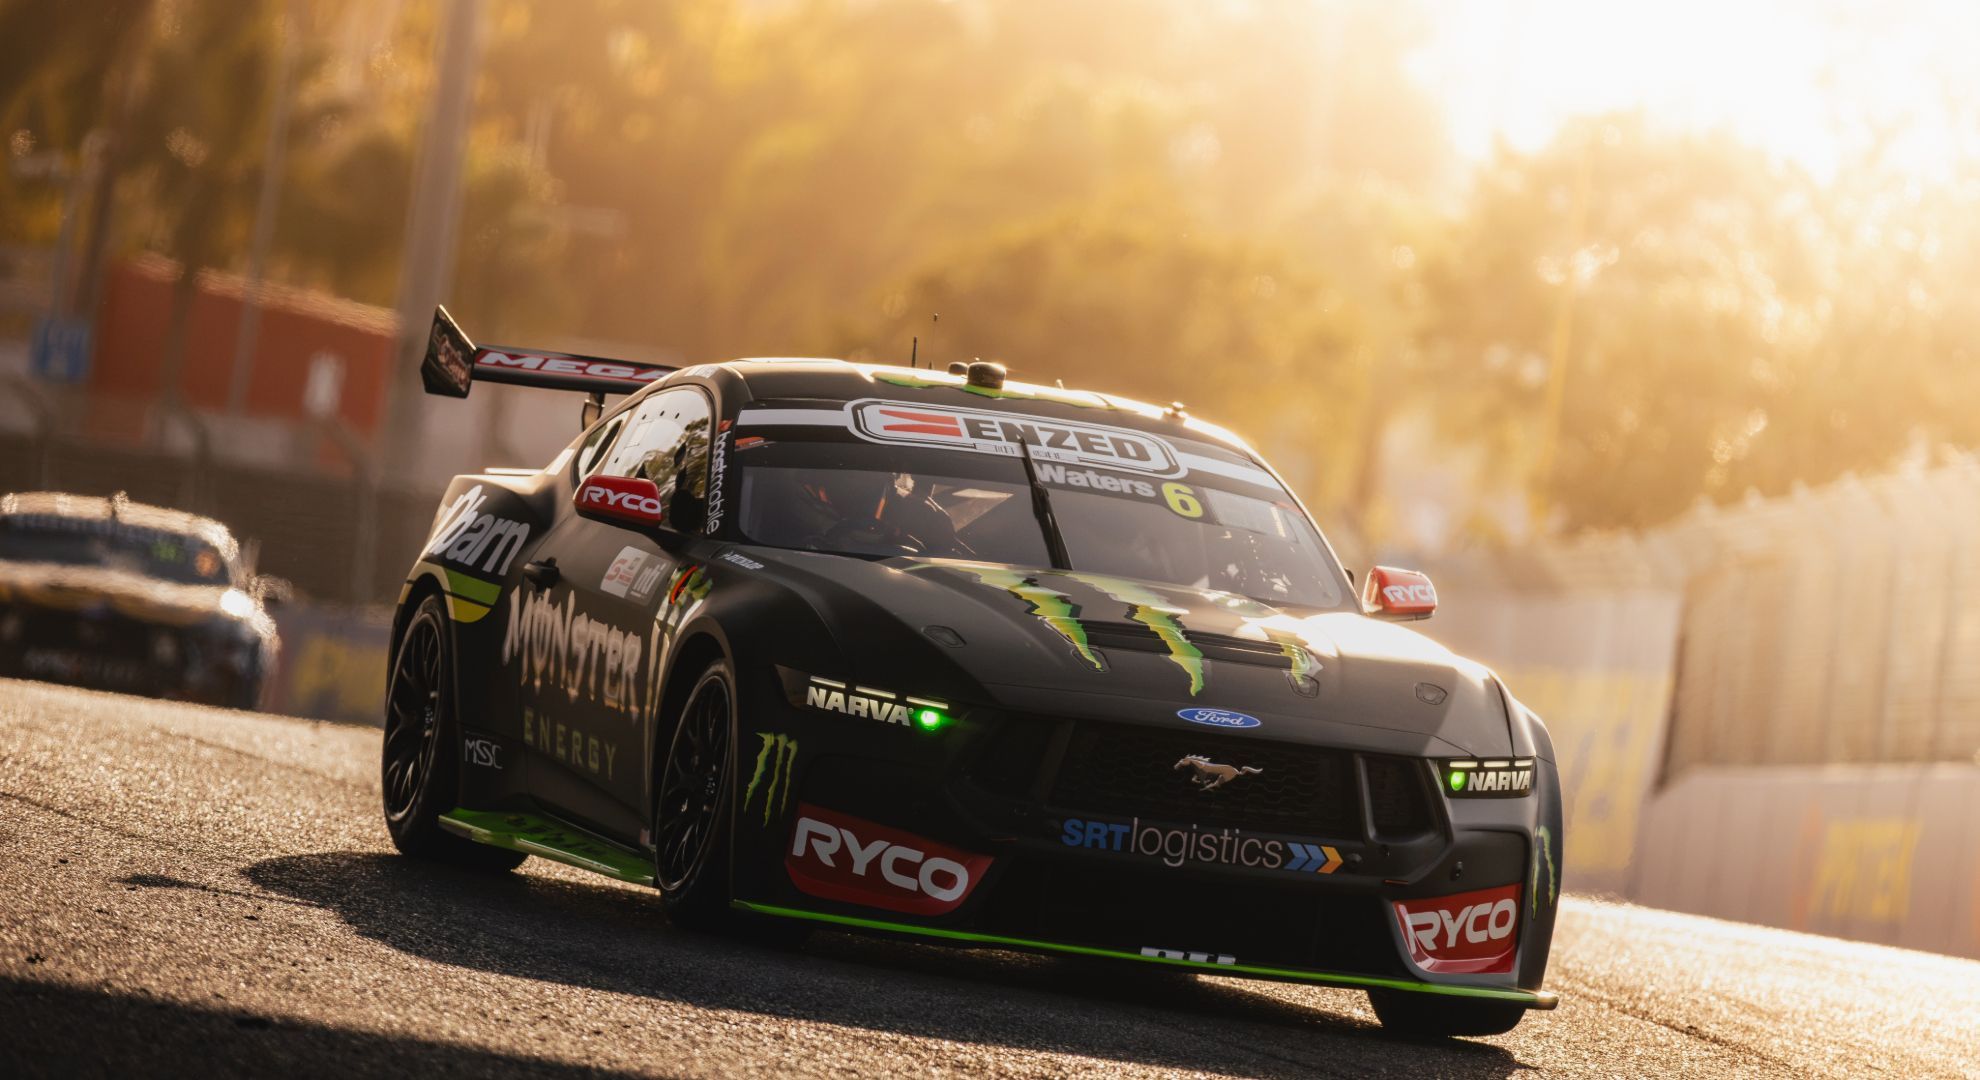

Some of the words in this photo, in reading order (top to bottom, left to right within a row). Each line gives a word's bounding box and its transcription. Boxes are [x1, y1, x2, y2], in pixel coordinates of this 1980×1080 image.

[962, 417, 1153, 462] ENZED
[582, 485, 662, 514] RYCO
[1033, 462, 1157, 498] Waters
[1161, 482, 1204, 518] 6
[502, 585, 641, 727] MONSTER
[806, 686, 911, 727] NARVA
[1194, 710, 1244, 726] Ford
[464, 737, 503, 770] MSC
[524, 707, 617, 780] ENERGY
[1467, 770, 1531, 792] NARVA
[792, 816, 969, 902] RYCO
[1405, 898, 1516, 955] RYCO
